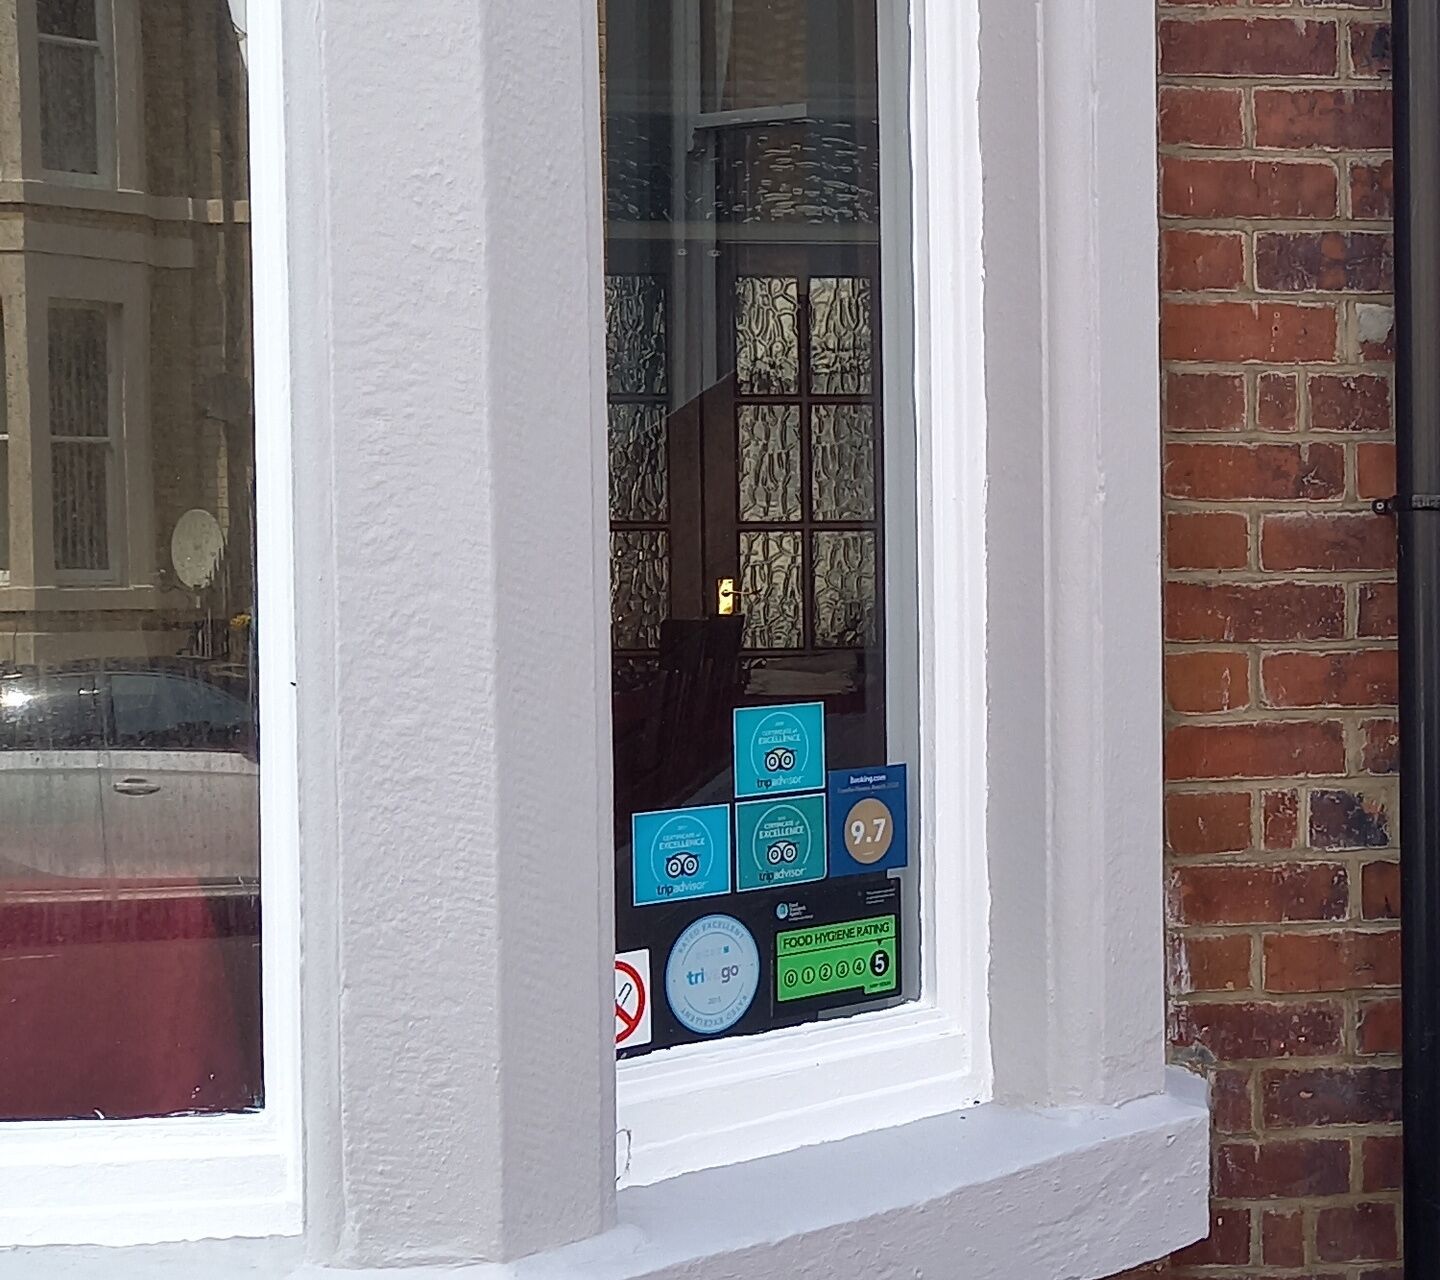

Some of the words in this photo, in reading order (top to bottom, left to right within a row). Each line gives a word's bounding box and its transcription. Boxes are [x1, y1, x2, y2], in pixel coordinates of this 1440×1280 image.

[759, 825, 804, 839] EXCELLENCE
[851, 818, 886, 845] 9.7
[658, 836, 705, 850] EXCELLENCE
[758, 867, 805, 884] tripadvisor
[656, 880, 706, 897] tripadvisor
[783, 934, 813, 950] FOOD
[814, 927, 856, 945] HYGIENE
[856, 921, 890, 938] RATING
[874, 953, 885, 973] 5
